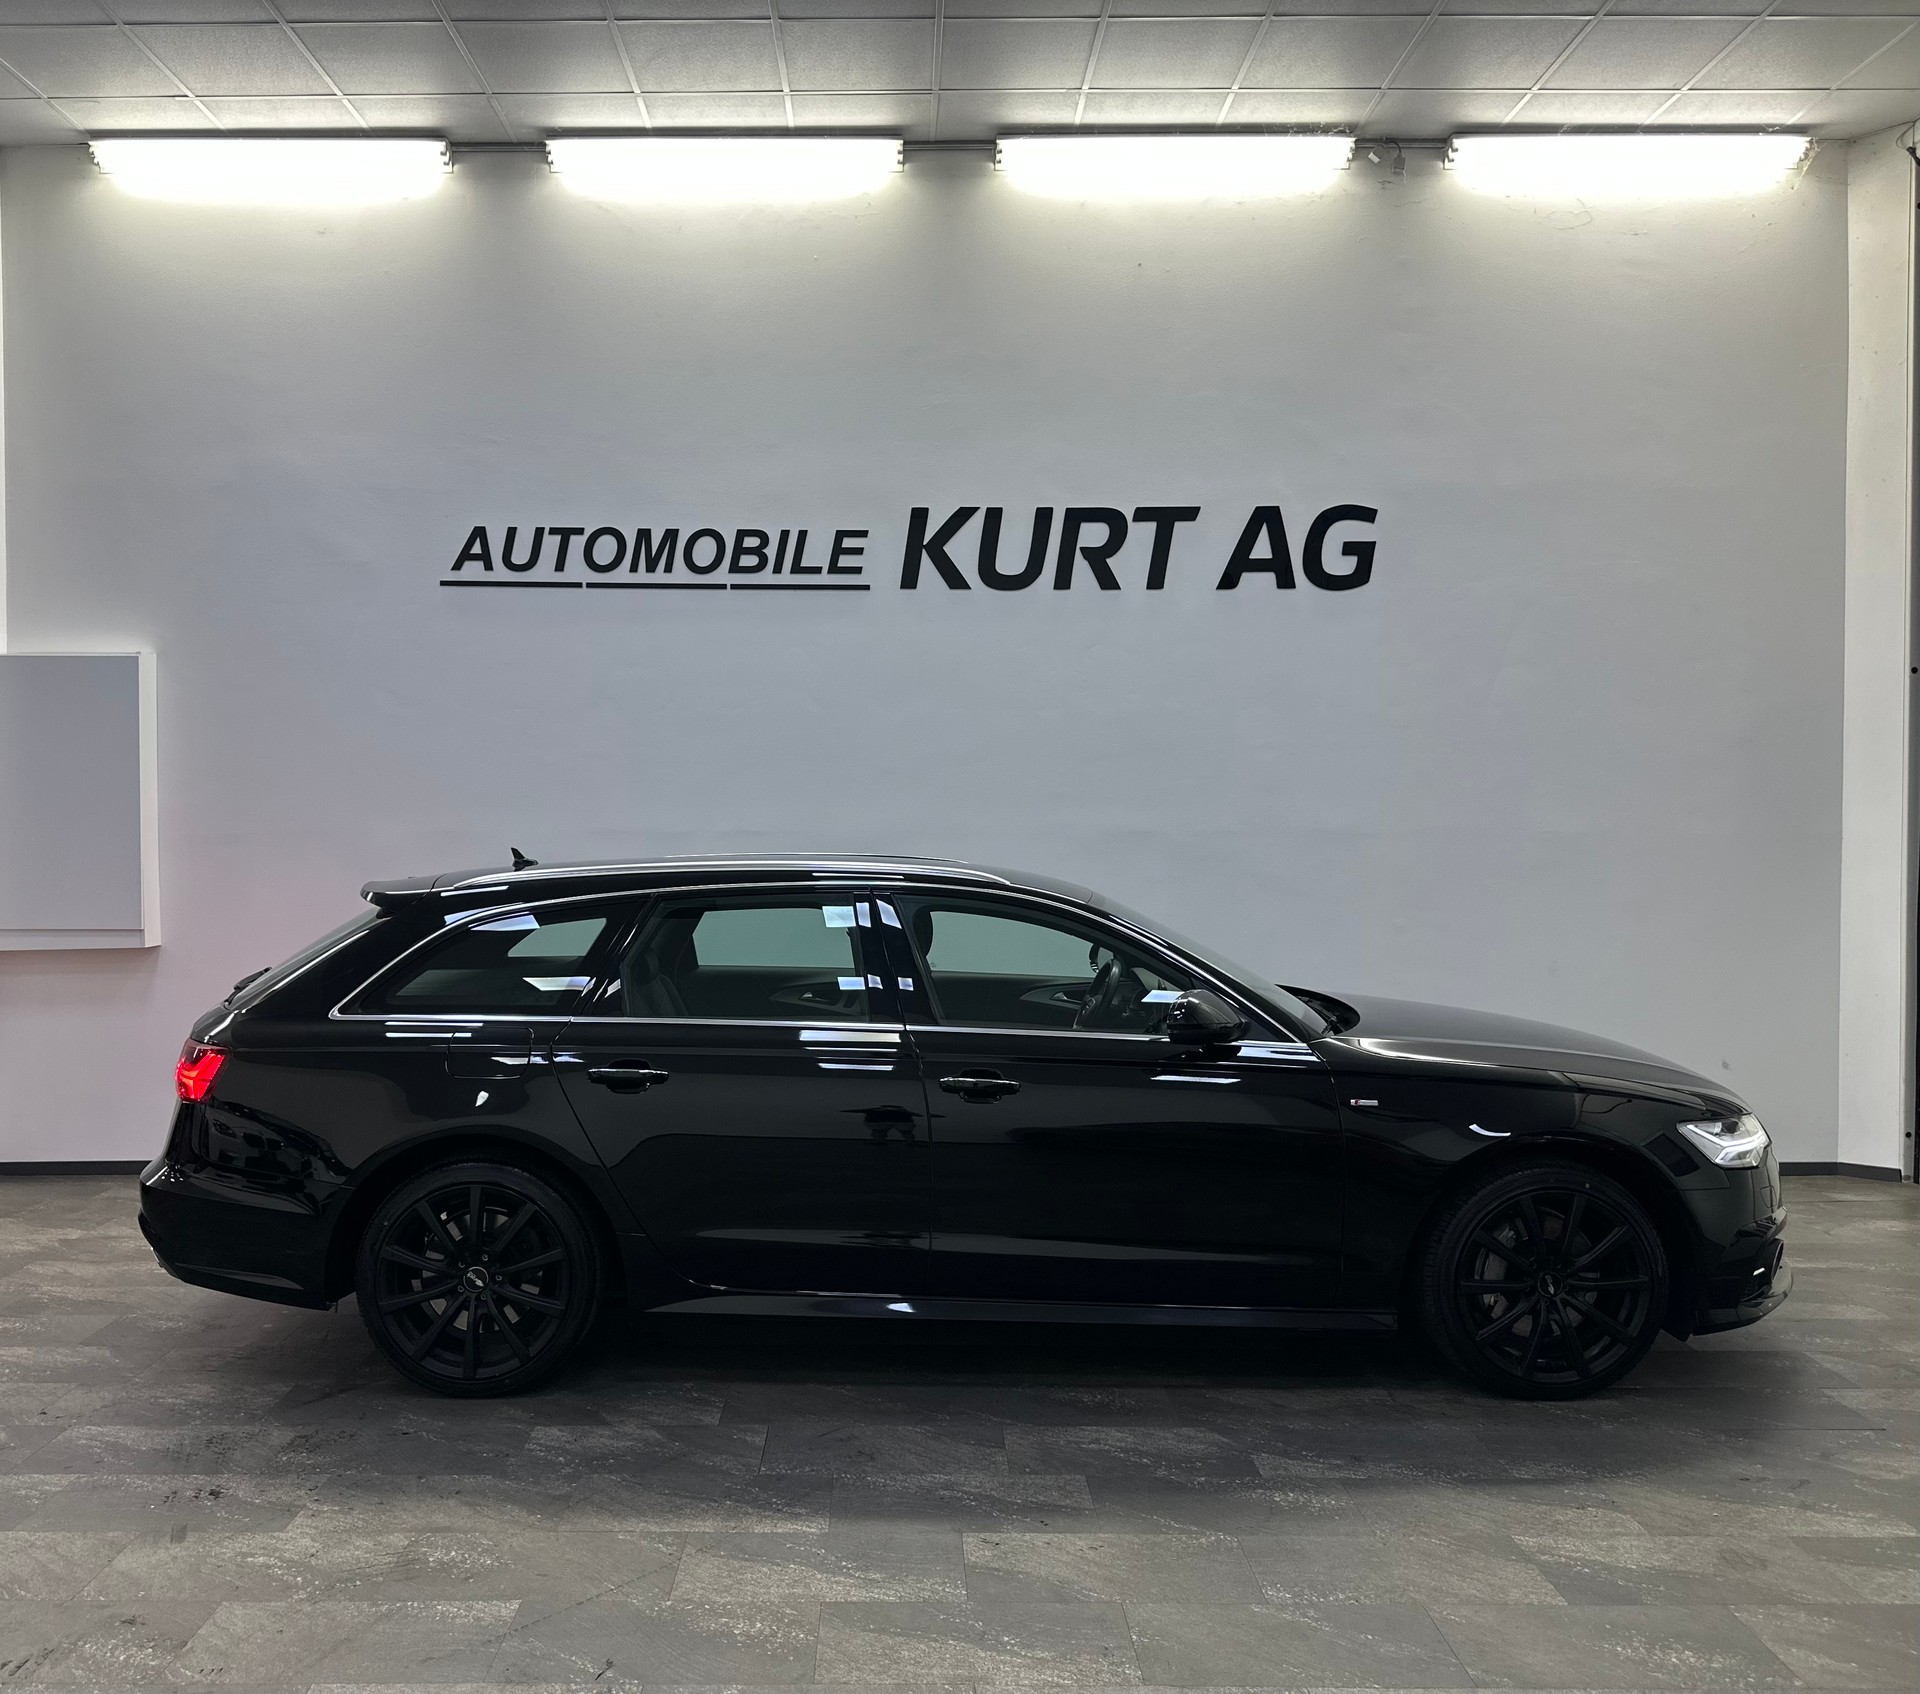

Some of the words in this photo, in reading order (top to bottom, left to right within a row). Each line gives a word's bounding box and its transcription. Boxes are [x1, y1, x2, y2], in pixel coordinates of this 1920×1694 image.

[451, 526, 869, 574] AUTOMOBILE
[899, 506, 1202, 592] KURT
[1216, 504, 1379, 591] AG
